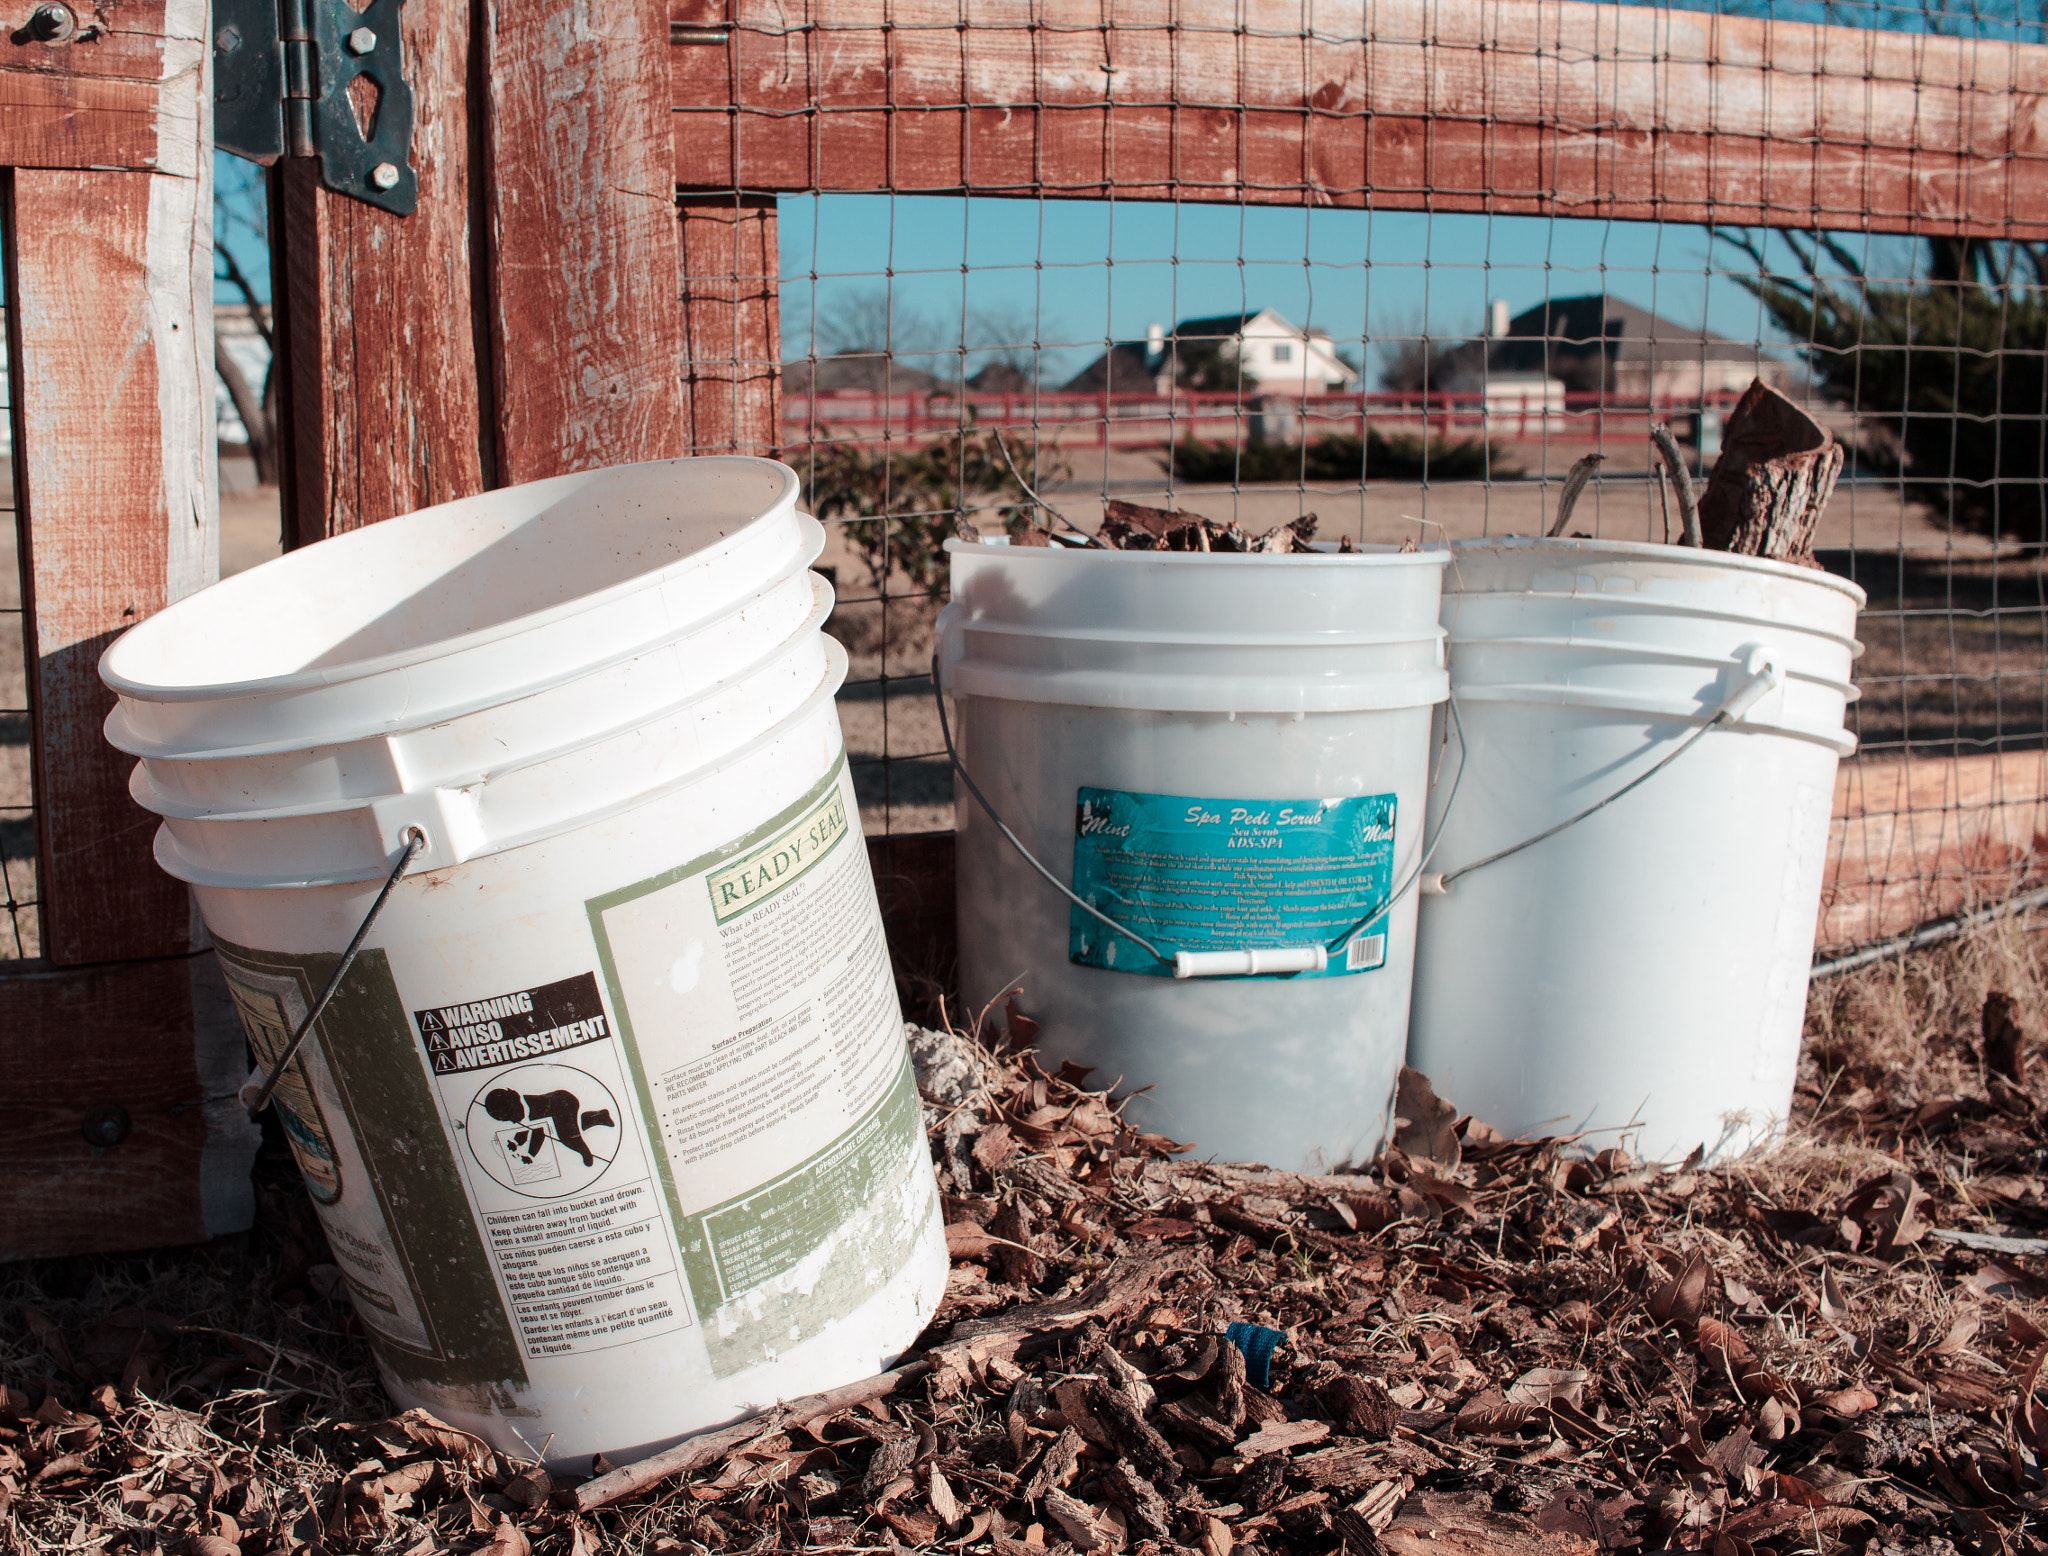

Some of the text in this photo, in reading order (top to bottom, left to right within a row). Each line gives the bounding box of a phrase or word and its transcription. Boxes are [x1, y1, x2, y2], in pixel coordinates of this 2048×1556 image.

[1082, 816, 1130, 837] Mint
[1184, 806, 1323, 827] Spa Pedi Scrub
[1232, 828, 1278, 836] Sea Scrub
[1228, 838, 1282, 848] KDS-SPA
[719, 838, 802, 906] READY
[719, 923, 743, 938] What
[744, 918, 751, 927] is
[752, 898, 780, 923] READY
[439, 991, 533, 1028] WARNING
[448, 1020, 503, 1049] AVISO
[455, 1014, 605, 1069] AVERTISSEMENT
[712, 1016, 773, 1050] Surface Preparation
[663, 1071, 687, 1084] Surface
[687, 1063, 704, 1075] must
[712, 1053, 728, 1064] clean
[665, 1083, 676, 1092] WE
[676, 1067, 714, 1088] RECOMMEND
[716, 1054, 742, 1072] APPLYING
[742, 1048, 754, 1059] ONE
[666, 1088, 687, 1101] PARTS
[674, 1112, 698, 1126] Caustic
[698, 1101, 724, 1116] strippers
[725, 1093, 740, 1104] must
[681, 1098, 706, 1113] previous
[707, 1089, 725, 1101] stains
[726, 1082, 737, 1093] and
[737, 1074, 757, 1087] sealers
[677, 1125, 694, 1136] Rinse
[727, 1102, 746, 1115] Before
[682, 1143, 704, 1156] Protect
[704, 1133, 727, 1148] against
[727, 1121, 754, 1138] overspray
[754, 1114, 765, 1125] and
[697, 1126, 714, 1137] hours
[722, 1116, 736, 1127] more
[737, 1101, 766, 1120] depending
[684, 1155, 698, 1165] with
[698, 1147, 719, 1160] plastic
[719, 1141, 732, 1150] drop
[733, 1133, 748, 1144] cloth
[747, 1125, 764, 1138] before
[816, 1140, 856, 1176] APPROXIMATE
[486, 1186, 645, 1225] Children can fall into bucket and drown.
[490, 1200, 637, 1237] Keep children away from bucket with
[494, 1238, 514, 1246] even
[521, 1232, 544, 1243] small
[545, 1226, 576, 1239] amount
[577, 1223, 586, 1233] of
[586, 1217, 614, 1230] liquid.
[498, 1252, 514, 1260] Los
[514, 1249, 536, 1258] niños
[537, 1244, 567, 1257] pueden
[568, 1238, 596, 1250] caerse
[604, 1231, 623, 1241] esta
[624, 1225, 644, 1236] cubo
[645, 1223, 650, 1232] y
[719, 1226, 763, 1248] SPRUCE FENCE
[721, 1237, 761, 1257] CEDAR FENCE
[505, 1247, 648, 1281] No deje que los niños se acerquen a
[508, 1256, 651, 1290] este cubo aunque sólo contenga una
[511, 1289, 546, 1302] pequeña
[546, 1283, 580, 1296] cantidad
[582, 1281, 592, 1290] de
[516, 1280, 654, 1314] Les enfants peuvent tomber dans le
[519, 1315, 539, 1323] seau
[539, 1312, 548, 1321] et
[548, 1312, 559, 1320] se
[523, 1325, 549, 1334] Garder
[550, 1323, 563, 1331] les
[564, 1318, 594, 1329] enfants
[594, 1315, 600, 1324] à
[647, 1300, 668, 1311] seau
[527, 1307, 673, 1344] contenant même une petite quantité
[530, 1346, 541, 1354] de
